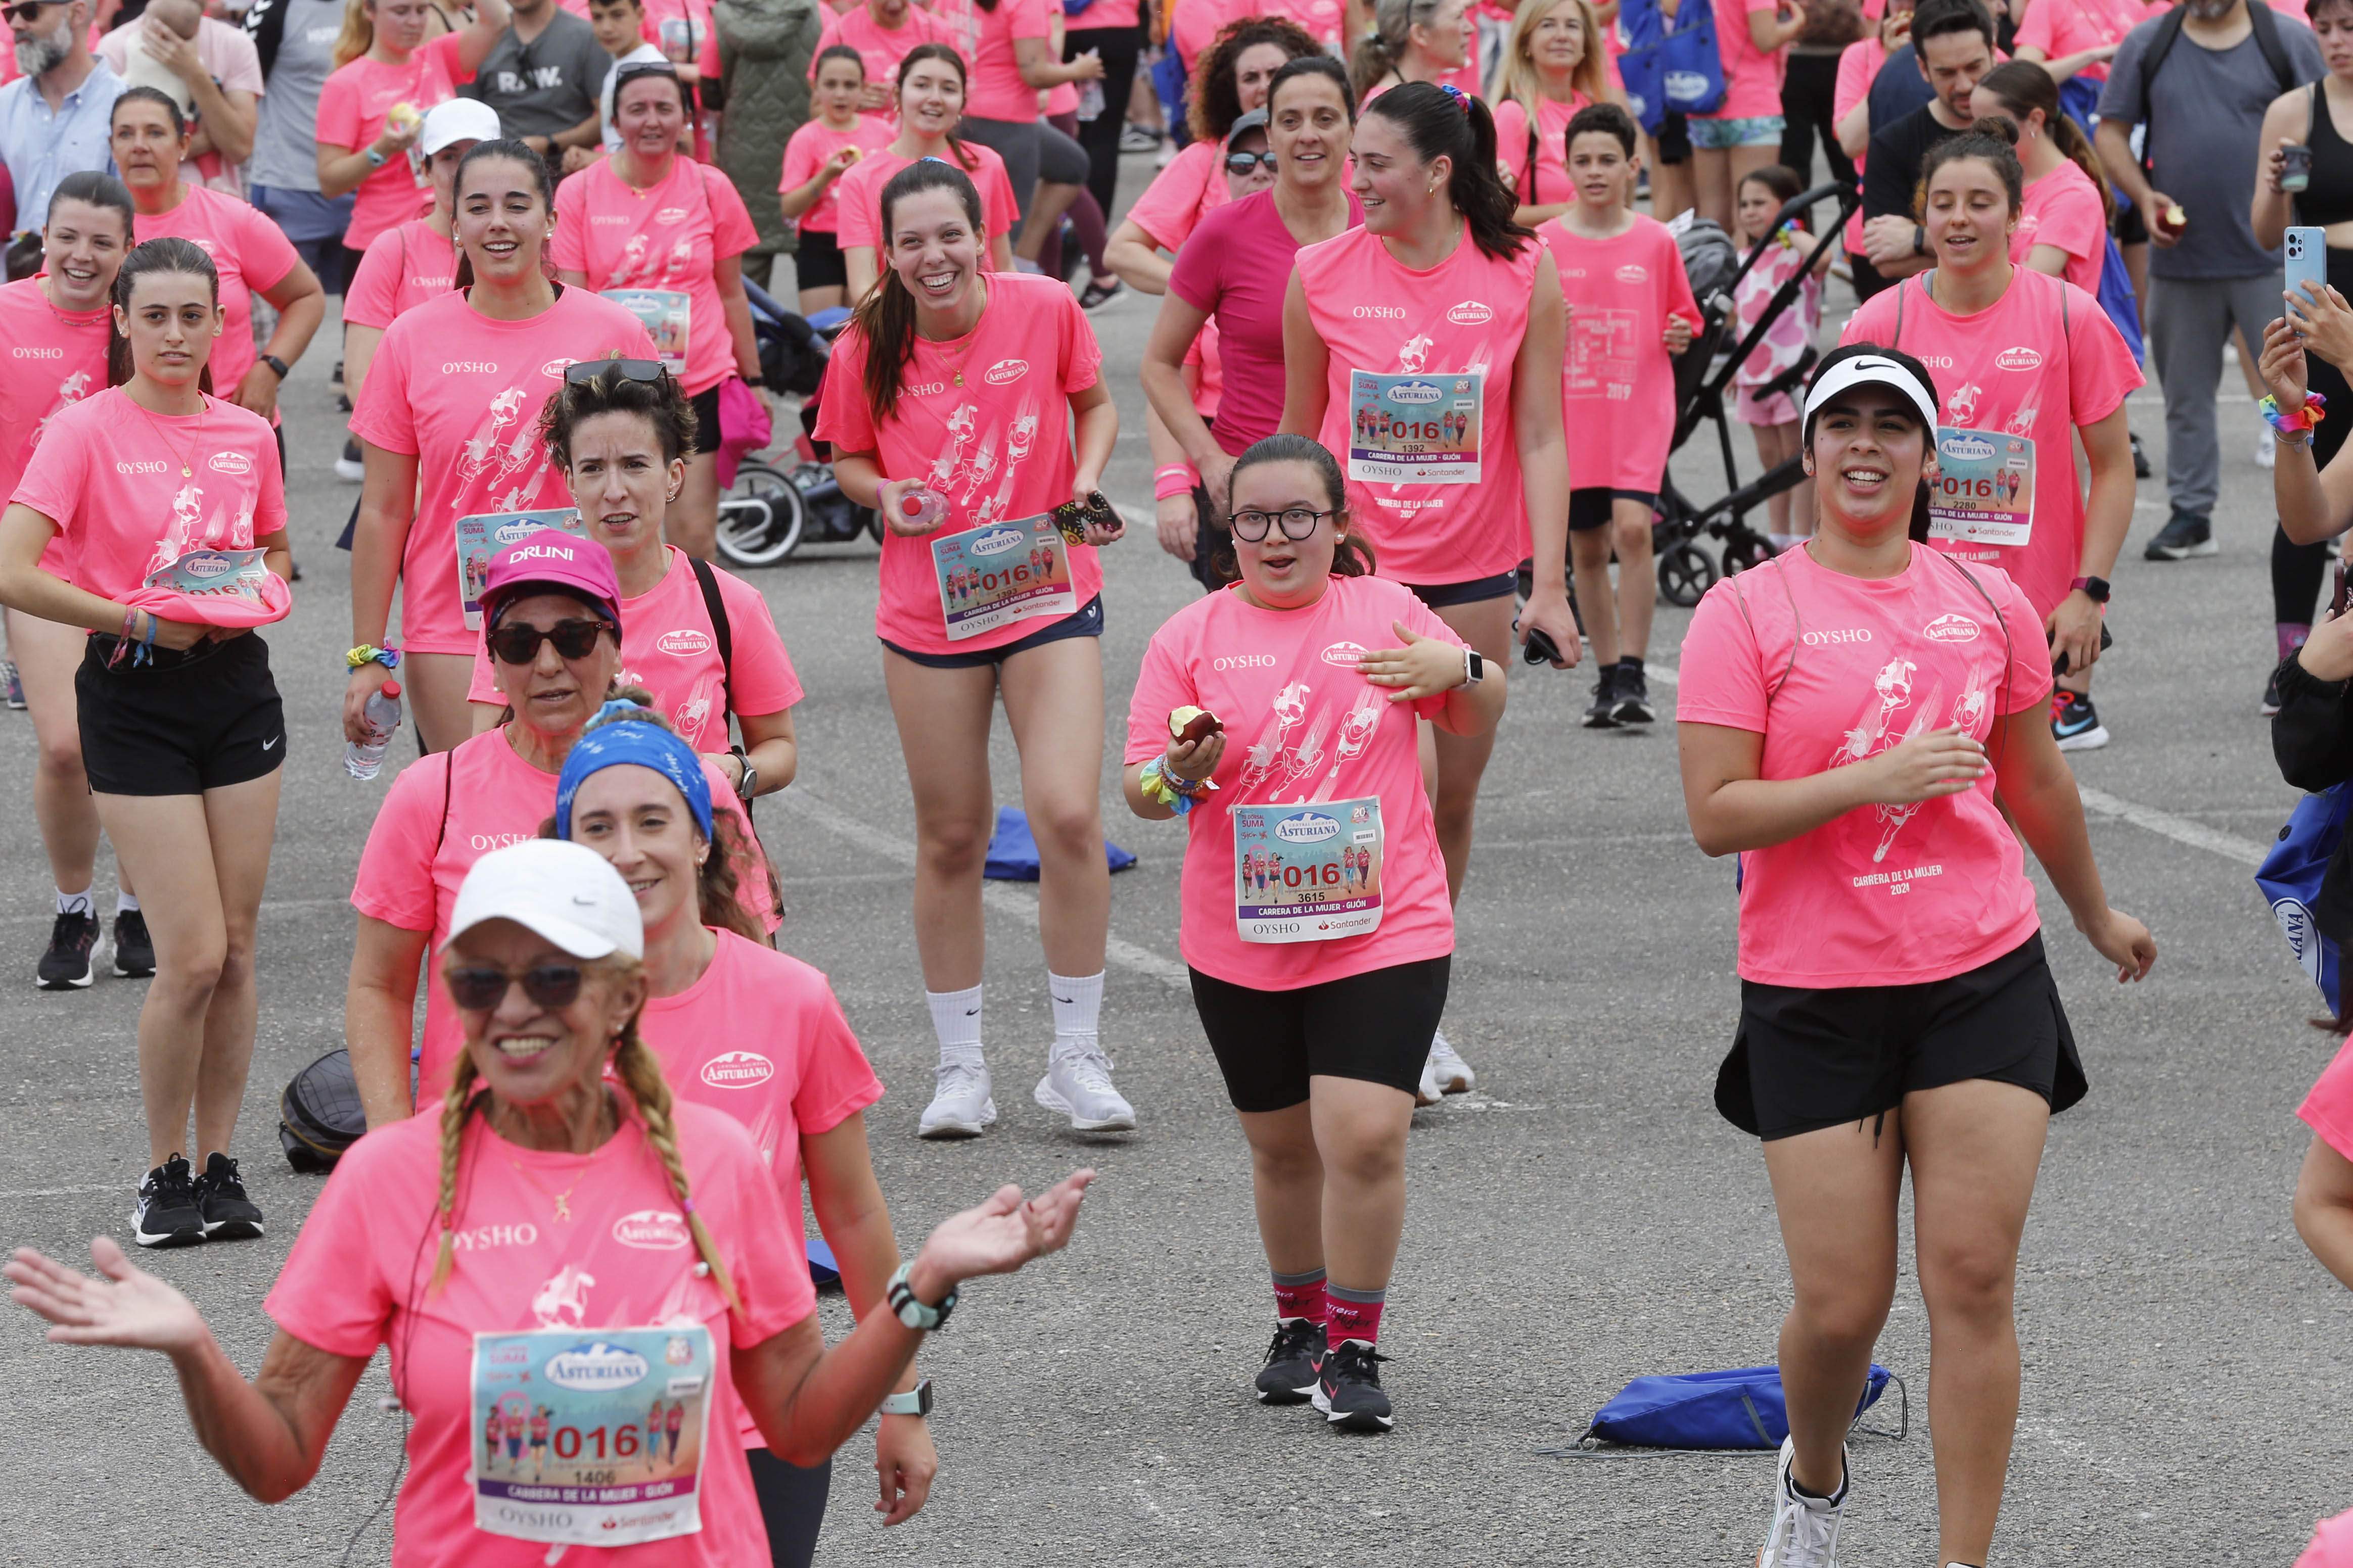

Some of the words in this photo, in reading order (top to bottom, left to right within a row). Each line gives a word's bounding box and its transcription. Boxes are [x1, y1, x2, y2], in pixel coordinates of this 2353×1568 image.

[1353, 306, 1406, 319] OYSHO
[1450, 311, 1489, 320] ASTURIANA
[13, 347, 63, 359] OYSHO
[1919, 356, 1953, 368] SHO
[1999, 356, 2039, 366] ASTURIANA
[442, 362, 497, 374] OYSHO
[989, 365, 1025, 382] ASTURIANA
[896, 382, 944, 398] OSHO
[1358, 382, 1378, 390] SUMA
[1456, 381, 1468, 389] 20
[1391, 390, 1439, 399] ASTURIANA
[1392, 421, 1440, 439] 016
[1944, 443, 1992, 455] ASTURIANA
[2011, 441, 2021, 449] 20
[1368, 452, 1395, 461] CARRERA
[117, 460, 167, 474] OYSHO
[213, 459, 247, 469] ASTURIANA
[1362, 465, 1402, 476] OYSHO
[1944, 477, 1991, 497] 016
[1403, 500, 1412, 508] DE
[1413, 501, 1421, 509] LA
[1422, 499, 1444, 507] MUJER
[1953, 501, 1976, 510] 2280
[566, 516, 577, 525] 20
[1994, 512, 2012, 521] GIJÓN
[1036, 519, 1048, 528] 20
[1930, 521, 1952, 531] SHO
[1978, 527, 2016, 537] Santander
[940, 545, 961, 555] SUMA
[975, 535, 1022, 553] ASTURIANA
[510, 545, 574, 564] DRUNI
[1978, 550, 2000, 560] MUJER
[188, 561, 227, 572] ASTURIANA
[982, 564, 1029, 590] 016
[996, 588, 1017, 599] 1393
[964, 606, 991, 617] CARRERA
[1001, 599, 1009, 607] LA
[1010, 592, 1031, 602] MUJER
[1035, 586, 1053, 594] GIJÓN
[1023, 599, 1060, 611] Santander
[961, 614, 999, 632] OYSHO
[1803, 629, 1872, 645] OYSHO
[1929, 628, 1975, 638] ASTURIANA
[662, 638, 708, 650] ASTURIANA
[1326, 651, 1359, 661] ASTURIA
[1214, 654, 1276, 671] OYSHO
[1354, 807, 1365, 818] 20
[1279, 825, 1336, 837] ASTURIANA
[1283, 863, 1340, 887] 016
[1853, 873, 1890, 887] CARRERA
[1891, 871, 1903, 882] DE
[1904, 869, 1914, 880] LA
[1915, 865, 1943, 878] MUJER
[1890, 883, 1910, 895] 2024
[1298, 892, 1325, 902] 3615
[1259, 906, 1290, 915] CARRERA
[1293, 906, 1302, 914] DE
[1304, 905, 1314, 913] LA
[1316, 903, 1341, 912] MUJER
[1347, 898, 1366, 909] GIJÓN
[1254, 923, 1300, 934] OYSHO
[1330, 917, 1371, 930] Santander
[707, 1067, 768, 1081] ASTURIANA
[553, 1360, 641, 1380] ASTURIANA
[553, 1424, 639, 1459] 016
[575, 1469, 616, 1485] 1406
[508, 1485, 559, 1501] CARRERA
[563, 1487, 579, 1502] DE
[581, 1488, 596, 1502] LA
[599, 1487, 637, 1502] MUJER
[499, 1506, 573, 1528] OYSHO
[620, 1510, 676, 1530] Santander
